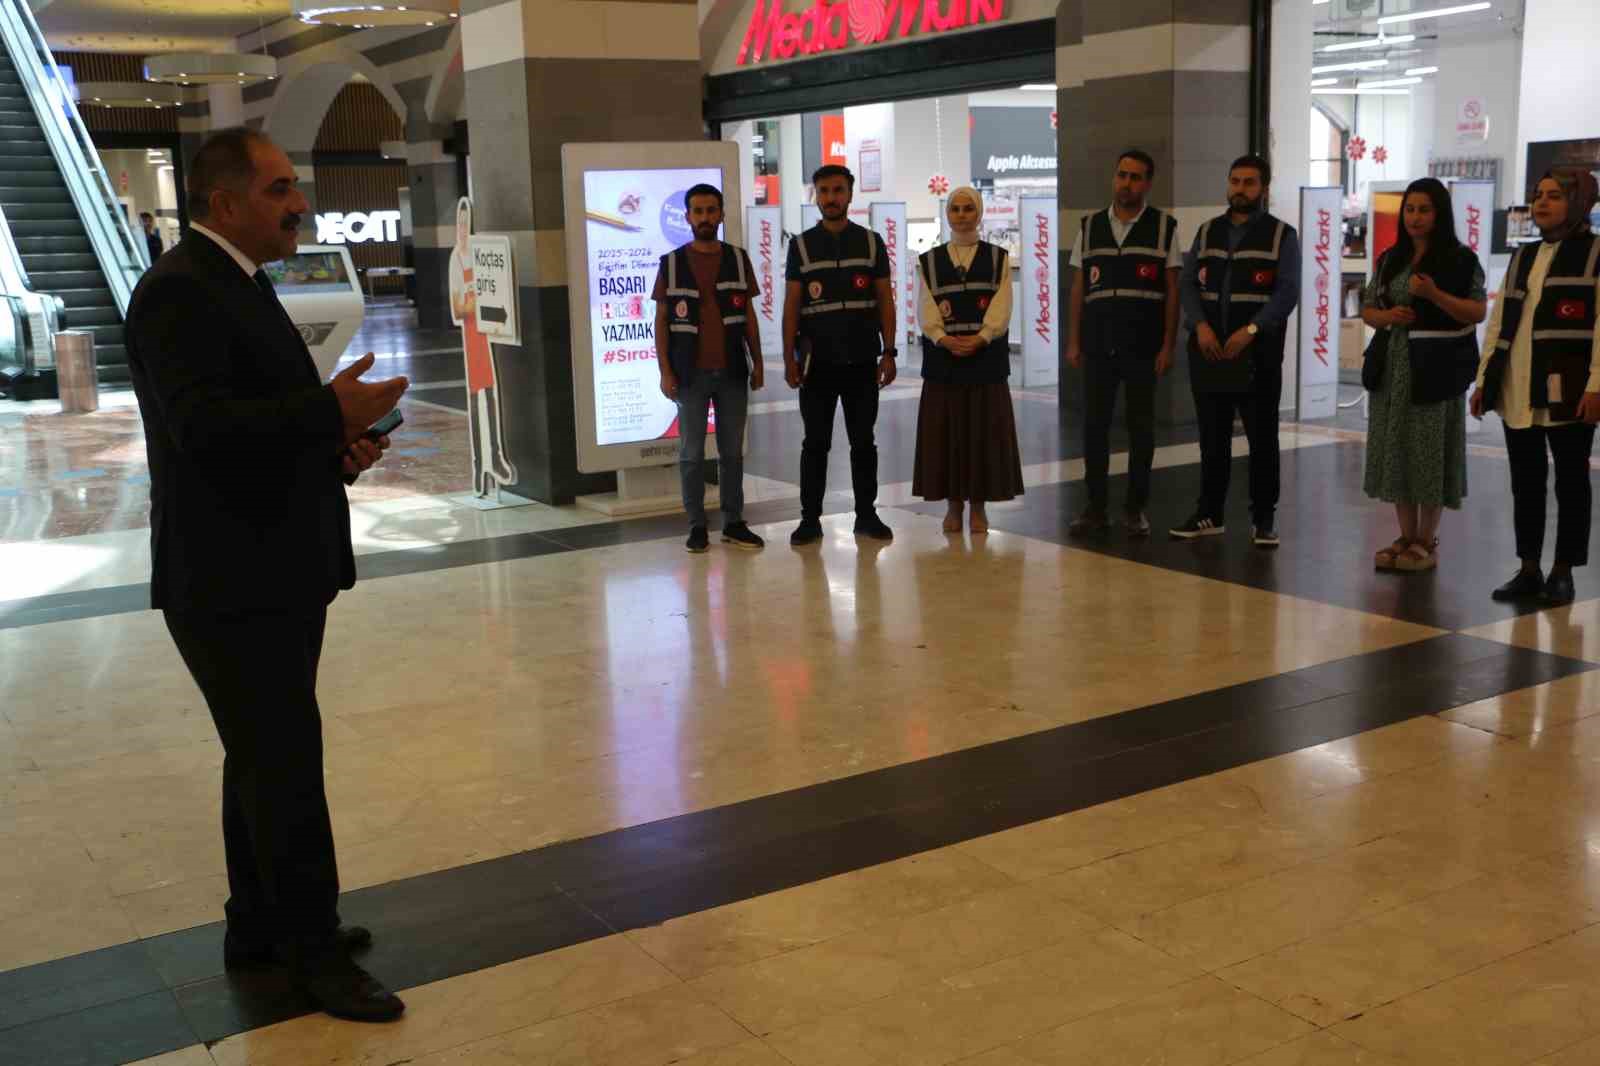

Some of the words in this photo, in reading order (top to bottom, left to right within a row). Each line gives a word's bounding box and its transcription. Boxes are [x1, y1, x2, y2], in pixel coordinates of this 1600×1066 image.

[736, 0, 850, 65] Media
[986, 155, 1019, 173] Apple
[473, 247, 505, 270] Koçtaş
[759, 219, 773, 266] Markt
[1033, 212, 1049, 270] Markt
[1314, 207, 1330, 277] Markt
[476, 273, 497, 296] giriş
[599, 275, 647, 299] BAŞARI
[760, 273, 774, 322] Media
[601, 321, 655, 342] YAZMAK
[1034, 282, 1051, 344] Media
[1313, 292, 1330, 368] Media
